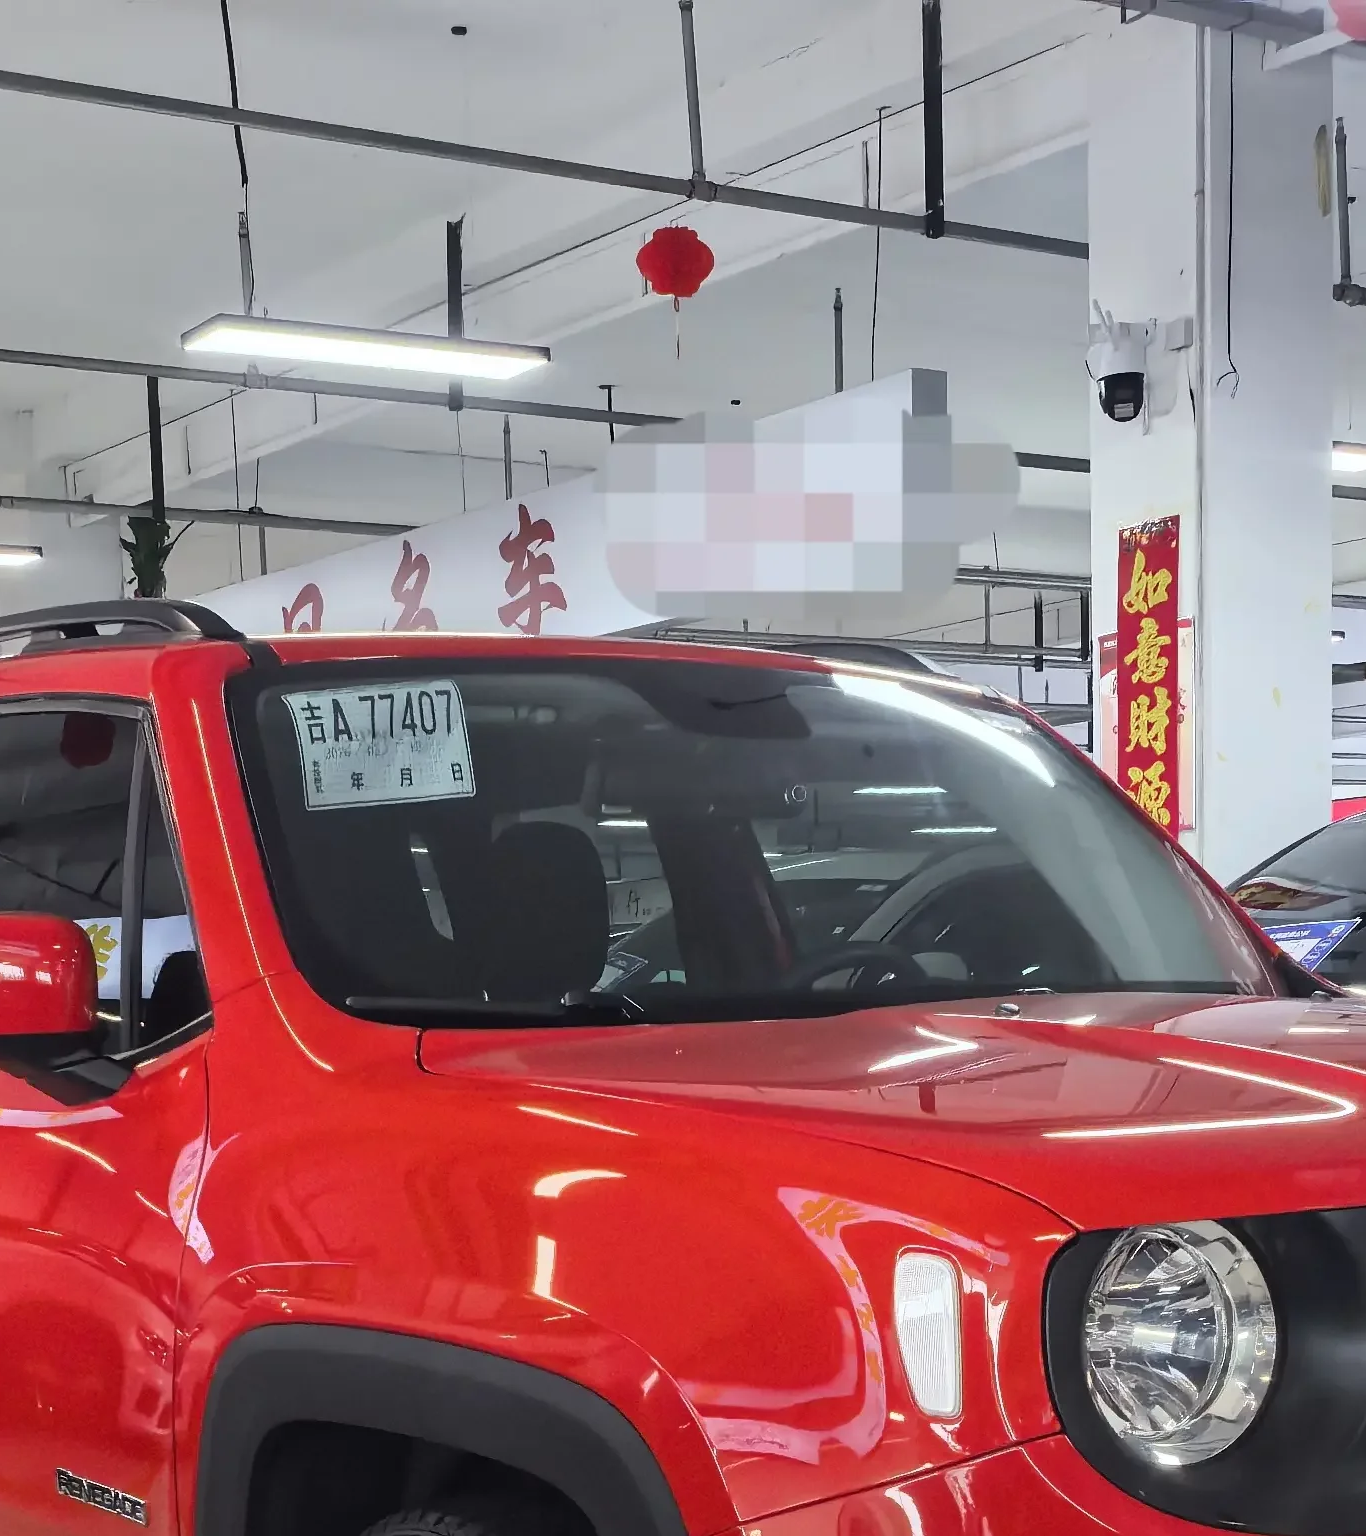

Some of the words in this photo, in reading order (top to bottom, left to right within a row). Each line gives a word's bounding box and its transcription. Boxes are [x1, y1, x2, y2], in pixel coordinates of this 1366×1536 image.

[350, 771, 365, 791] 年
[400, 767, 414, 787] 月
[450, 762, 464, 782] 日
[55, 1467, 149, 1527] RENEGADE
